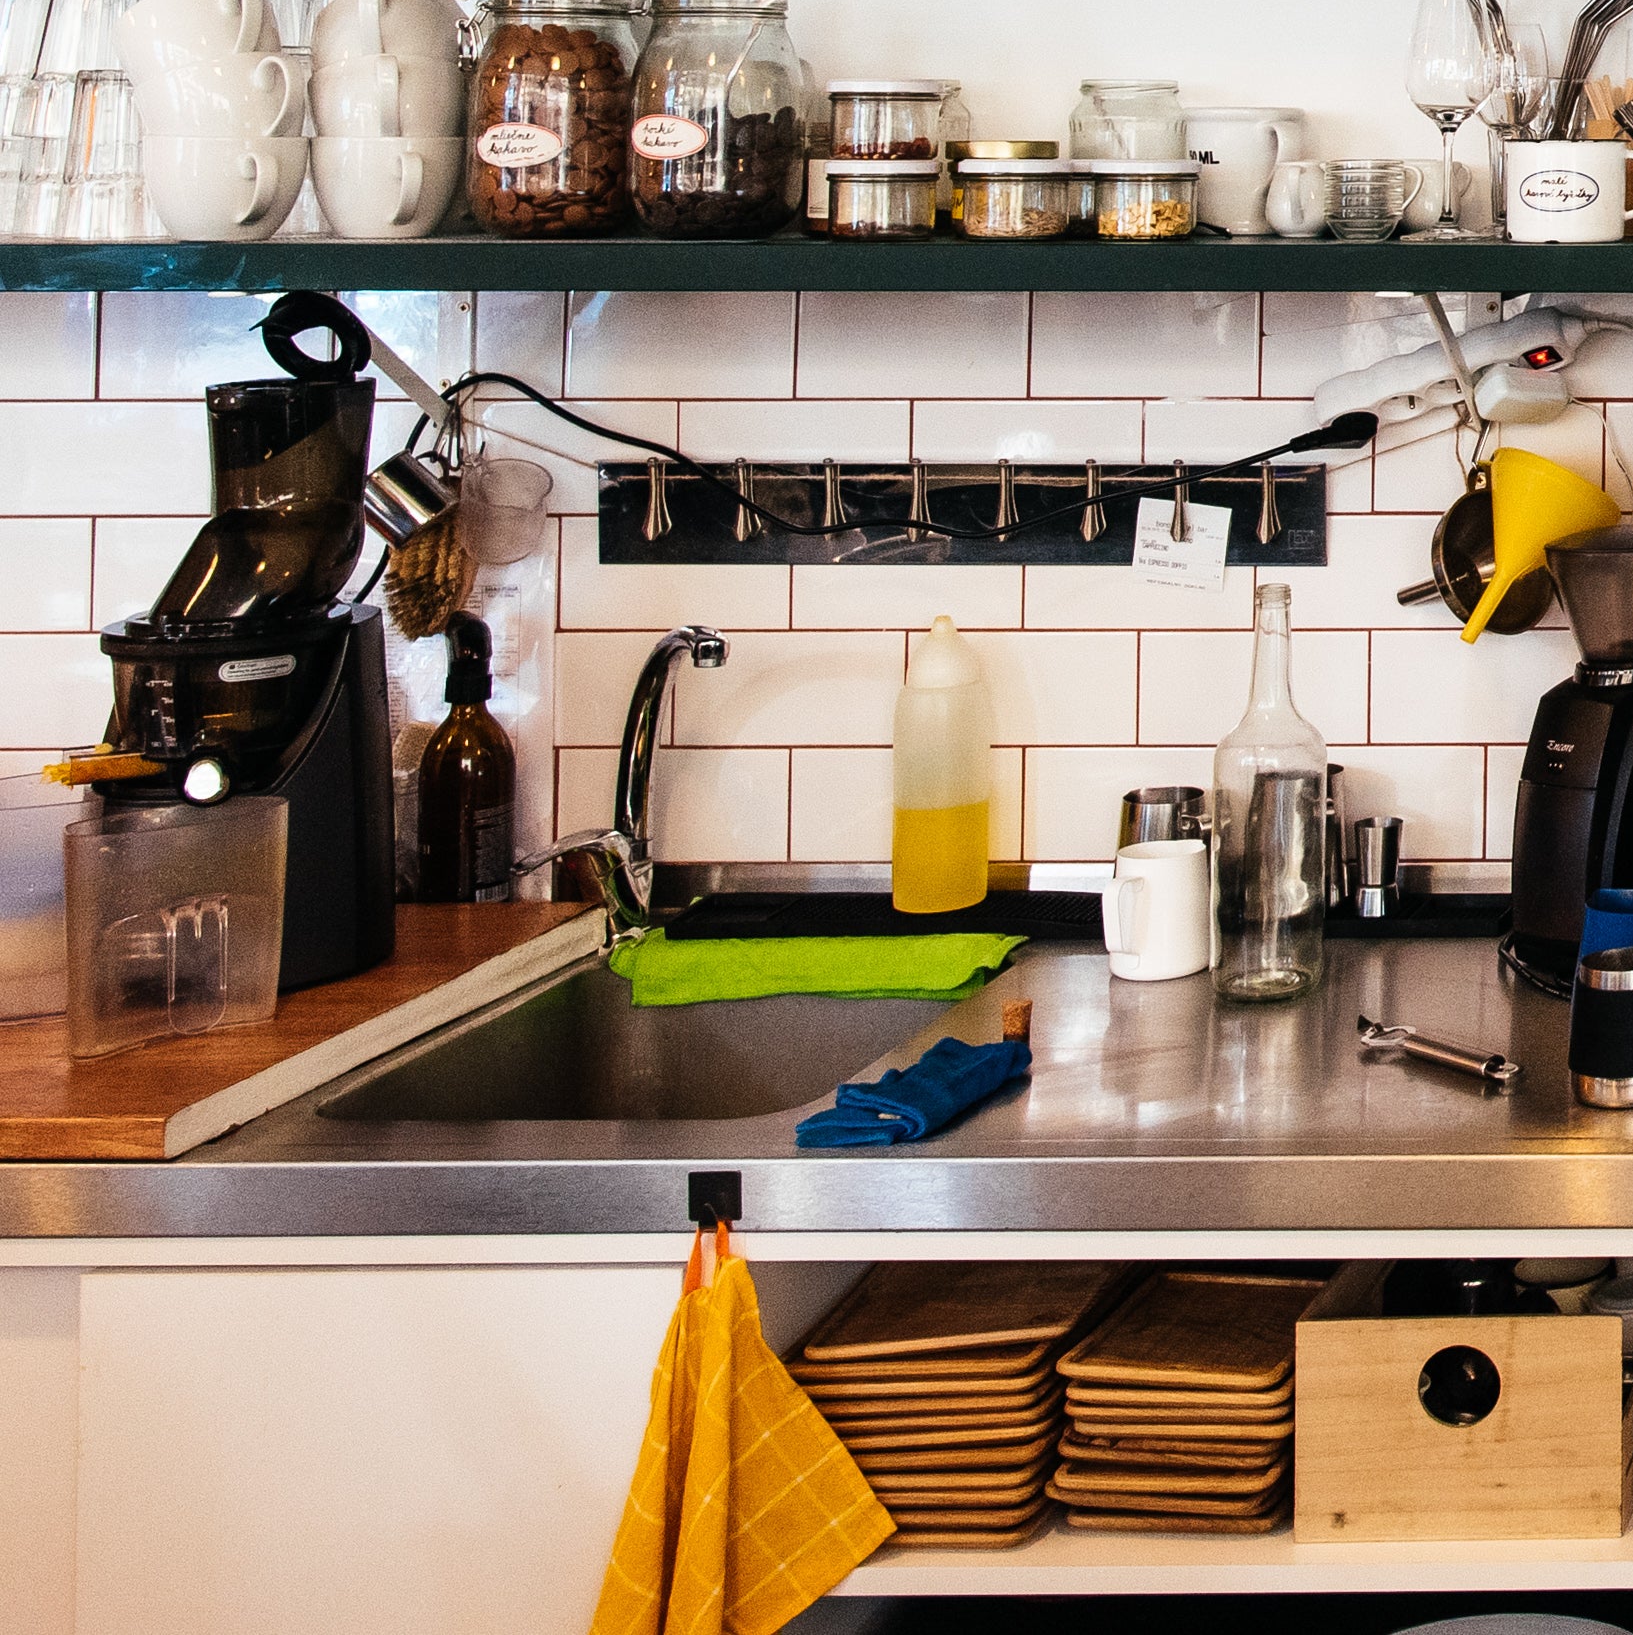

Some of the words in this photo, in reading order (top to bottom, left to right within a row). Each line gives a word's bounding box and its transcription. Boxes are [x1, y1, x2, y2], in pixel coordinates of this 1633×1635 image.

[488, 141, 538, 157] kakavo
[642, 136, 683, 148] kakavo
[1547, 739, 1575, 753] Encore
